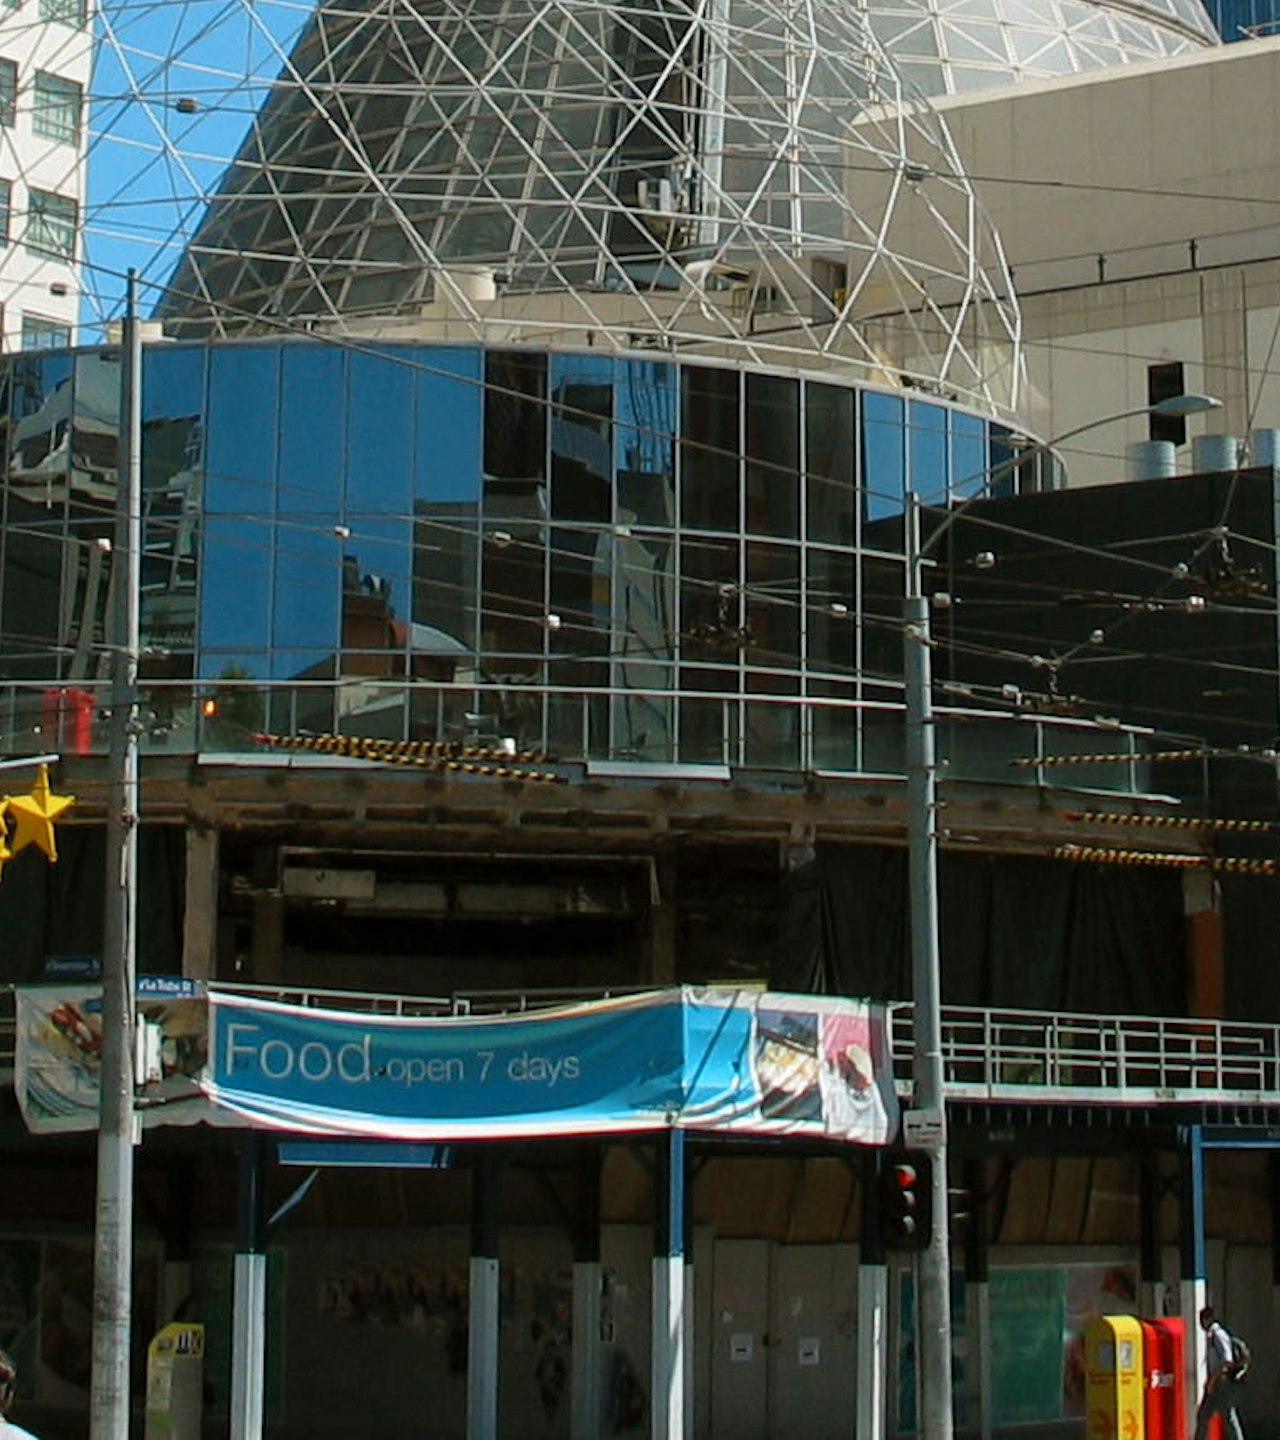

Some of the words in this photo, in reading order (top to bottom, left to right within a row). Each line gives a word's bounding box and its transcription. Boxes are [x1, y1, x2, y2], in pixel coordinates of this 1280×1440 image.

[224, 1023, 371, 1083] Food
[386, 1056, 464, 1087] open
[476, 1051, 494, 1081] 7
[507, 1051, 581, 1087] days
